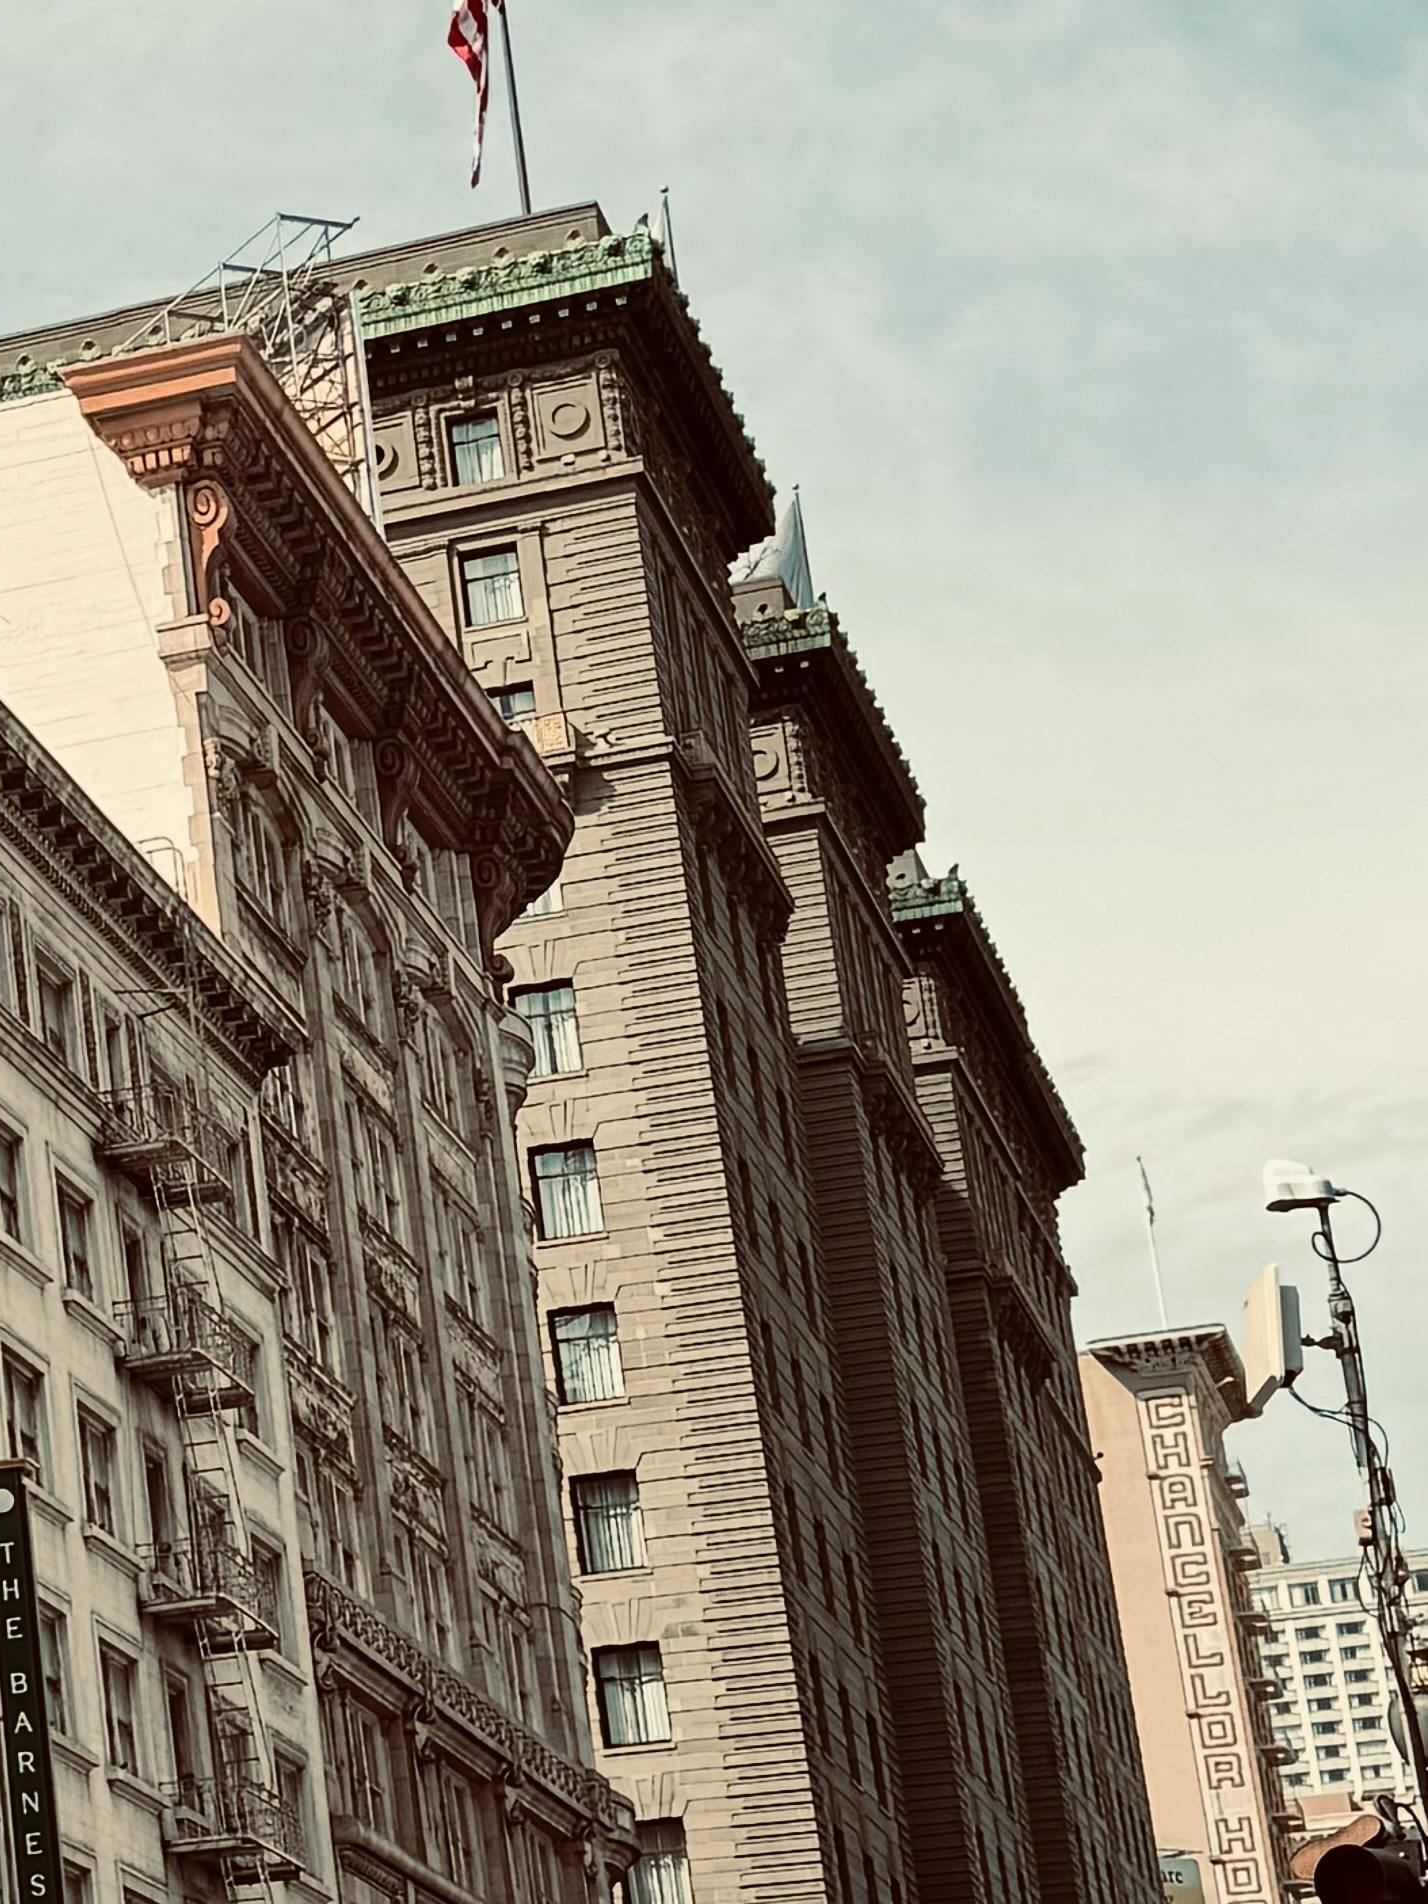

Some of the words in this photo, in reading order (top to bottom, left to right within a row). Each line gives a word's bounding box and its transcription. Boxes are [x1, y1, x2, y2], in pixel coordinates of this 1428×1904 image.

[0, 1541, 24, 1640] THE
[1145, 1395, 1245, 1790] CHANCELLOR
[9, 1671, 46, 1897] BARNES
